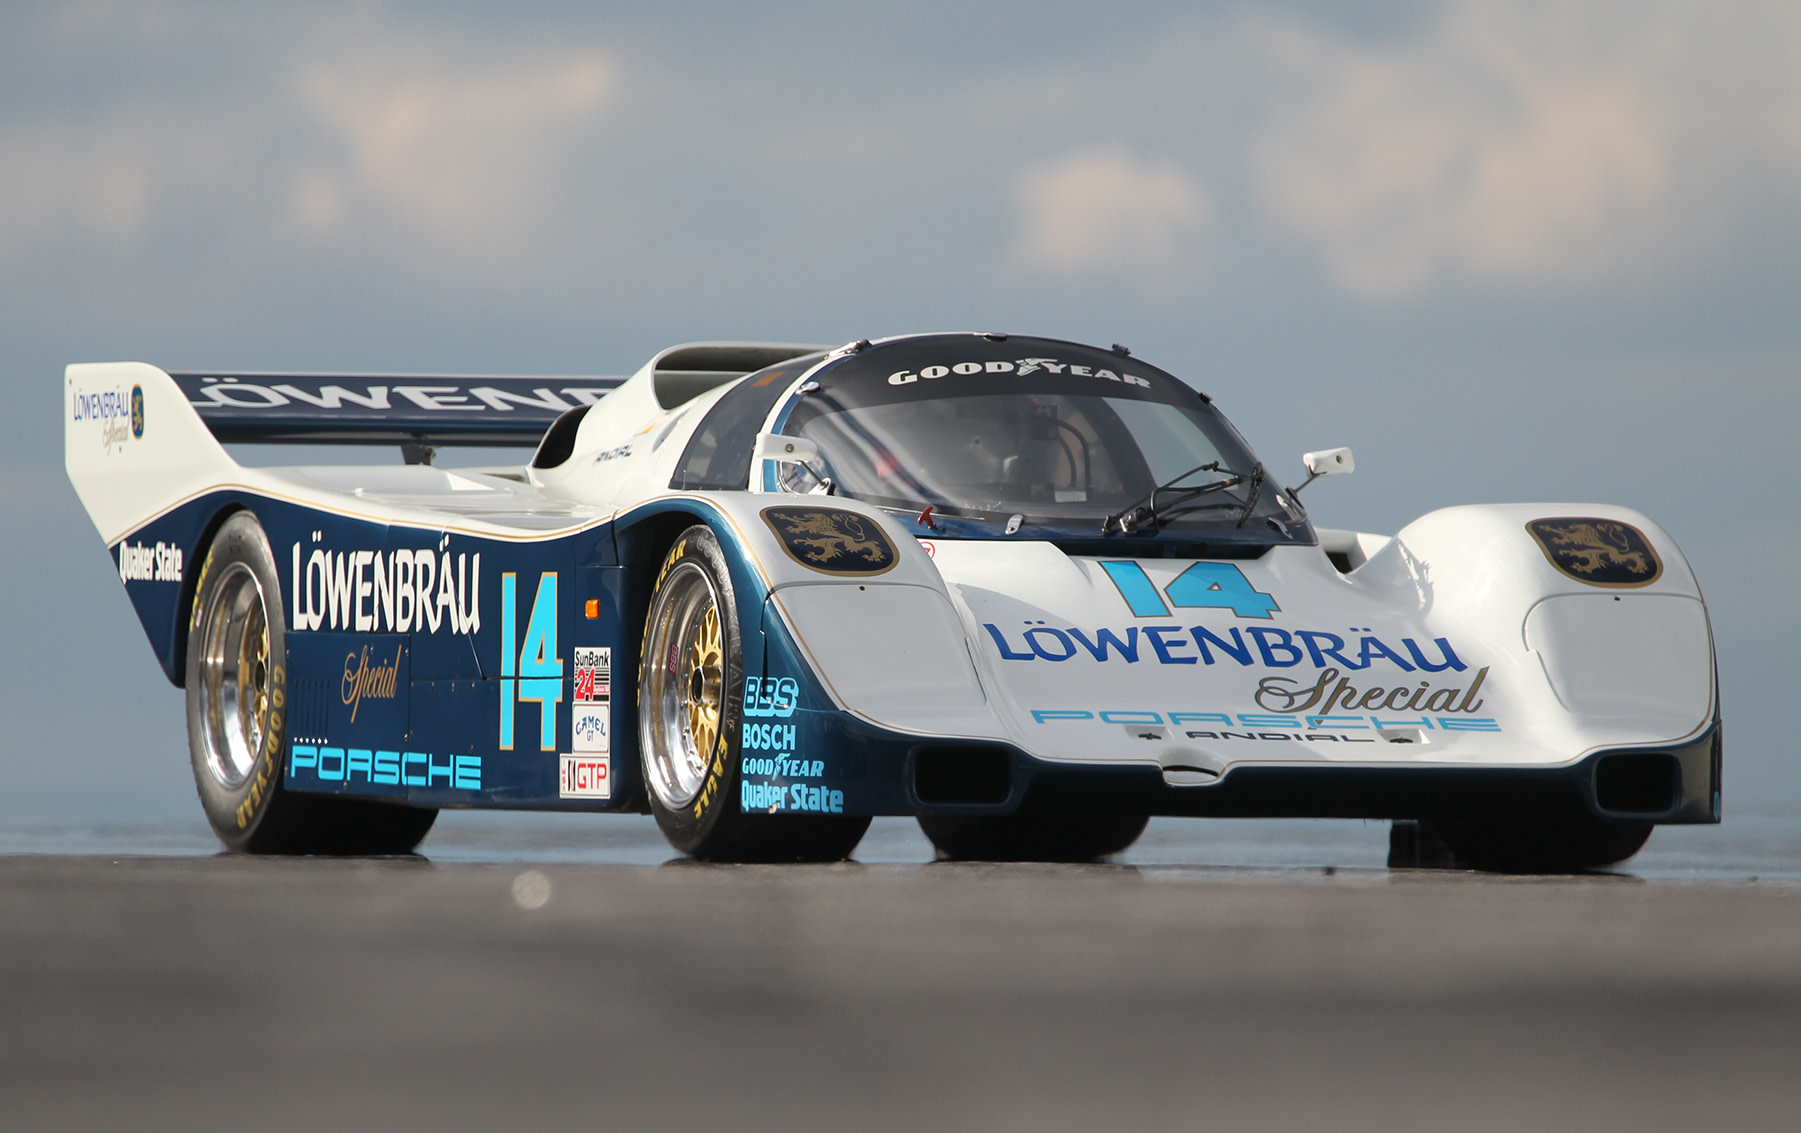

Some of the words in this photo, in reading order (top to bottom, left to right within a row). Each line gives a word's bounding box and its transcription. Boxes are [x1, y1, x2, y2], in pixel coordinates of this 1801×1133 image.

[119, 540, 155, 586] Quaker
[155, 541, 182, 582] State
[293, 530, 481, 635] LÖWENBRÄU
[1097, 560, 1282, 620] 14
[499, 571, 563, 752] 14
[575, 651, 609, 667] SunBank
[983, 621, 1468, 673] LÖWENBRÄU
[341, 645, 402, 724] Special
[575, 668, 595, 700] 24
[743, 676, 799, 717] BBS
[1254, 666, 1490, 728] Special
[575, 716, 606, 736] CAMEL
[587, 730, 594, 742] GT
[742, 724, 796, 750] BOSCH
[1030, 709, 1502, 732] PORSCHE
[1186, 731, 1375, 742] ANDIAL
[291, 745, 482, 790] PORSCHE
[577, 763, 607, 789] GTP
[741, 780, 788, 812] Quaker
[790, 783, 844, 813] State
